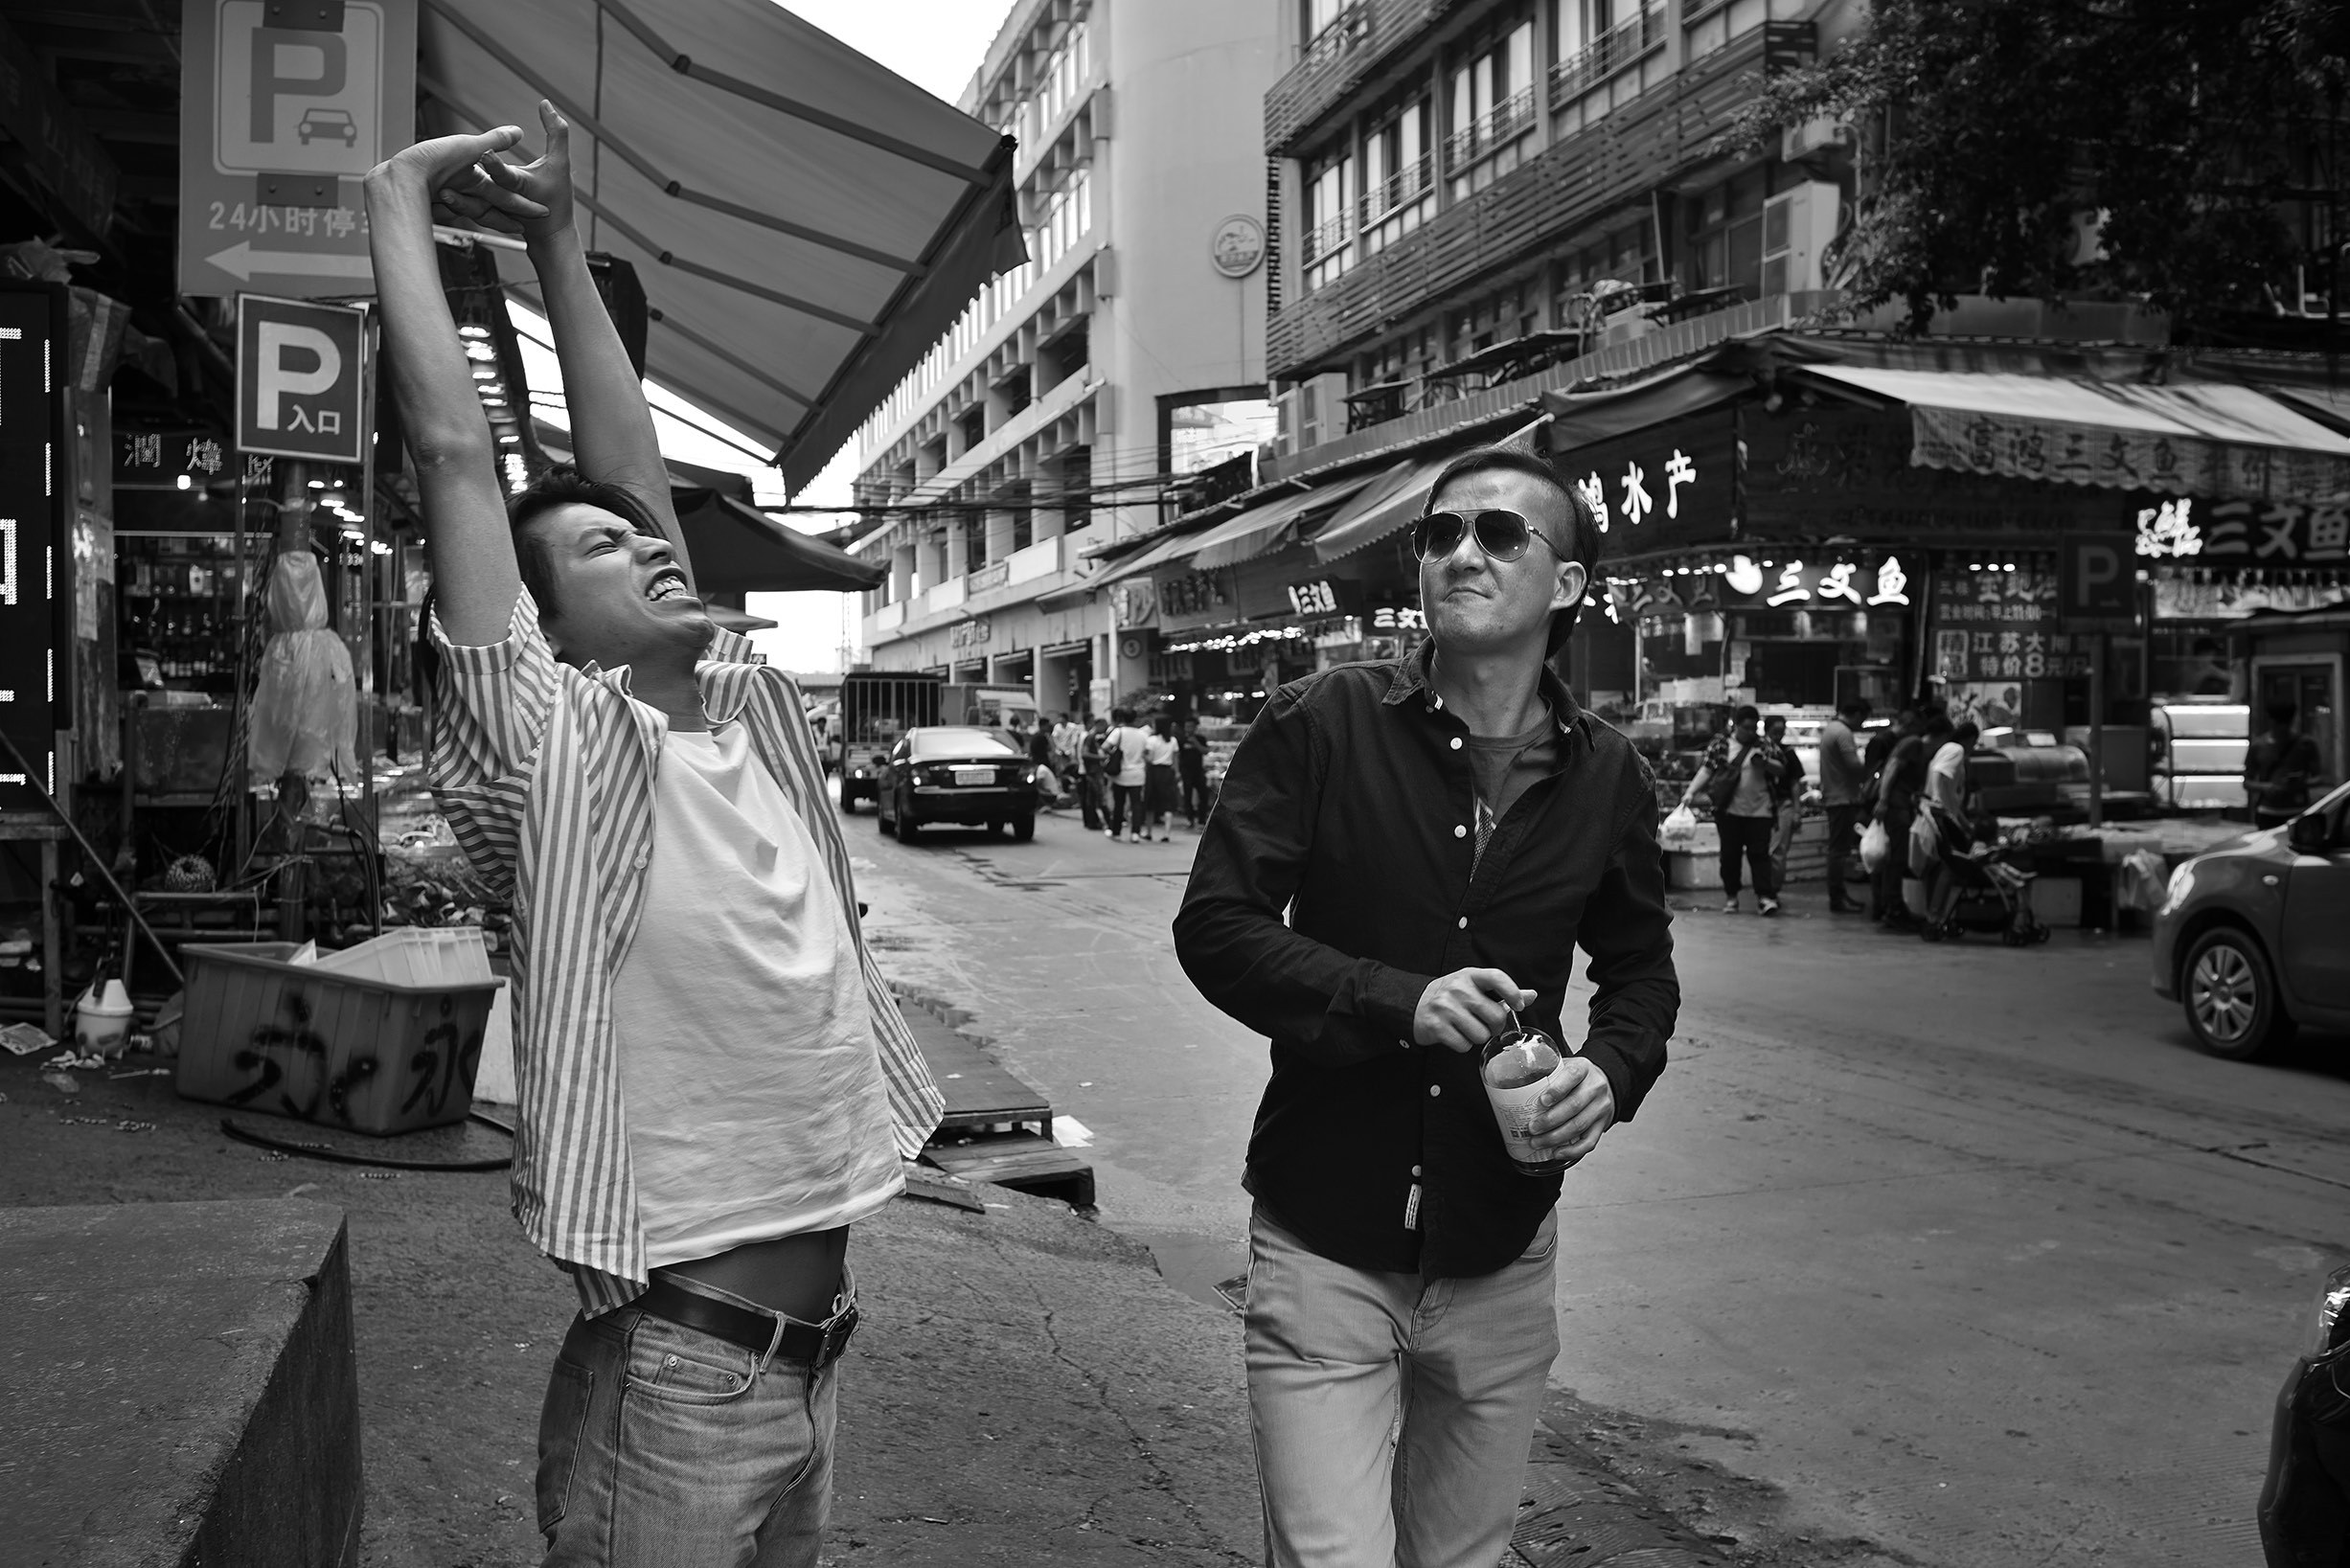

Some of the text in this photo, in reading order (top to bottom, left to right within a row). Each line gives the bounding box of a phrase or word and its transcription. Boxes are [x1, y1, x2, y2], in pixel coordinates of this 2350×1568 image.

[249, 27, 347, 144] P
[209, 200, 370, 239] 24小时停
[257, 320, 341, 431] P
[286, 403, 341, 435] 入口
[2204, 501, 2348, 560] 三文鱼
[1766, 556, 1910, 607] 三文鱼
[2076, 544, 2120, 608] P
